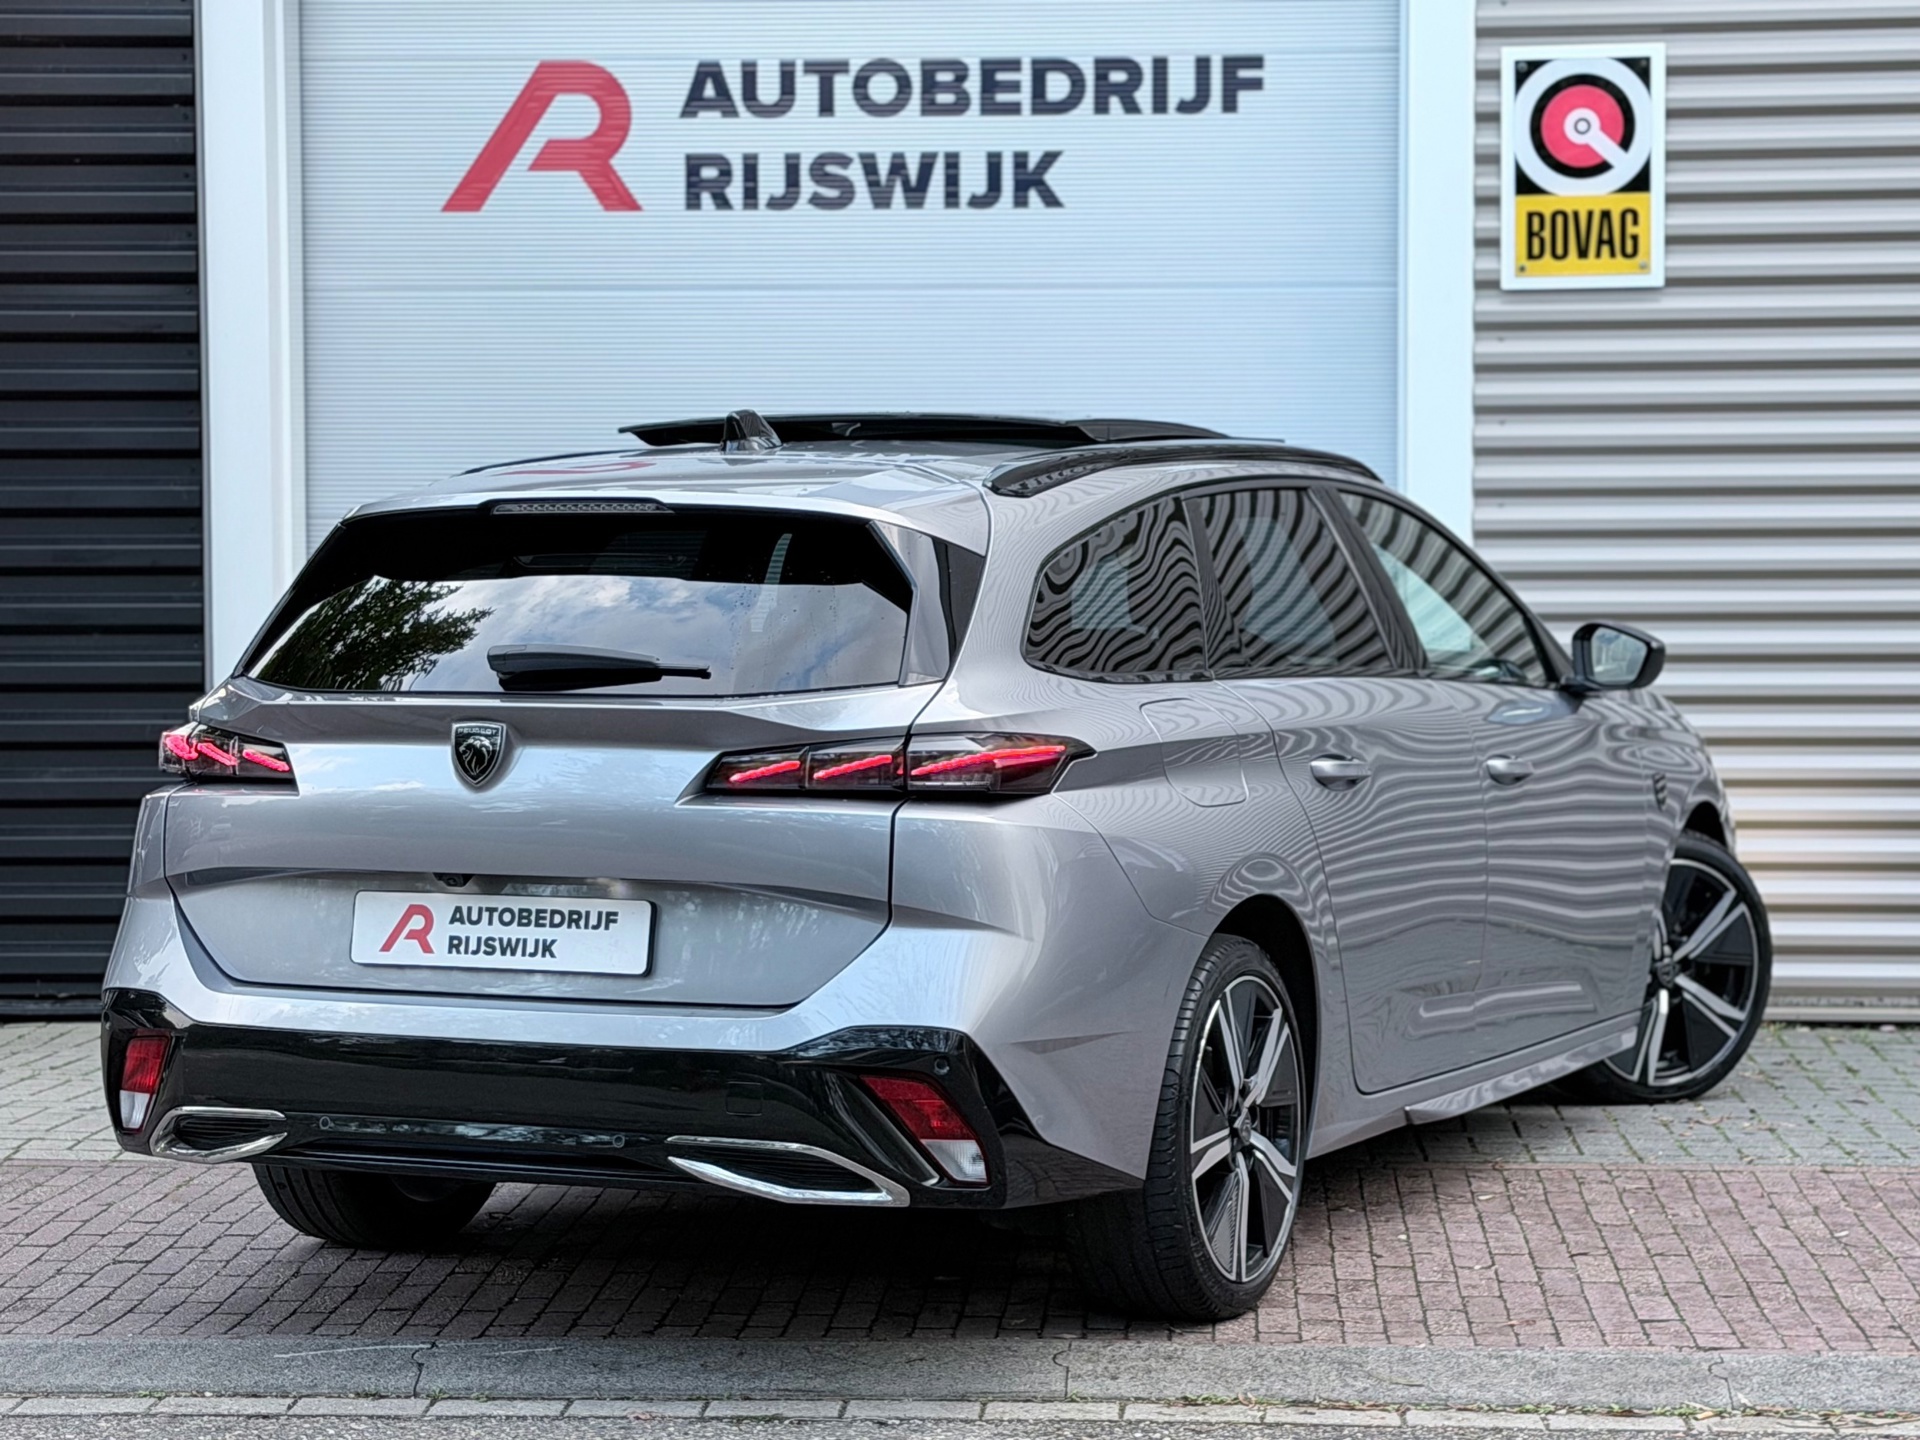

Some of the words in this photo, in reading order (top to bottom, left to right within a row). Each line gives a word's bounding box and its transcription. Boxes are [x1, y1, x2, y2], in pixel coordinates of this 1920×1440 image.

[680, 55, 1264, 118] AUTOBEDRIJF
[684, 151, 1065, 211] RIJSWIJK
[1526, 208, 1639, 261] BOVAG
[457, 727, 498, 735] PEUGEOT
[449, 905, 619, 931] AUTOBEDRIJF
[447, 935, 558, 959] RIJSWIJK
